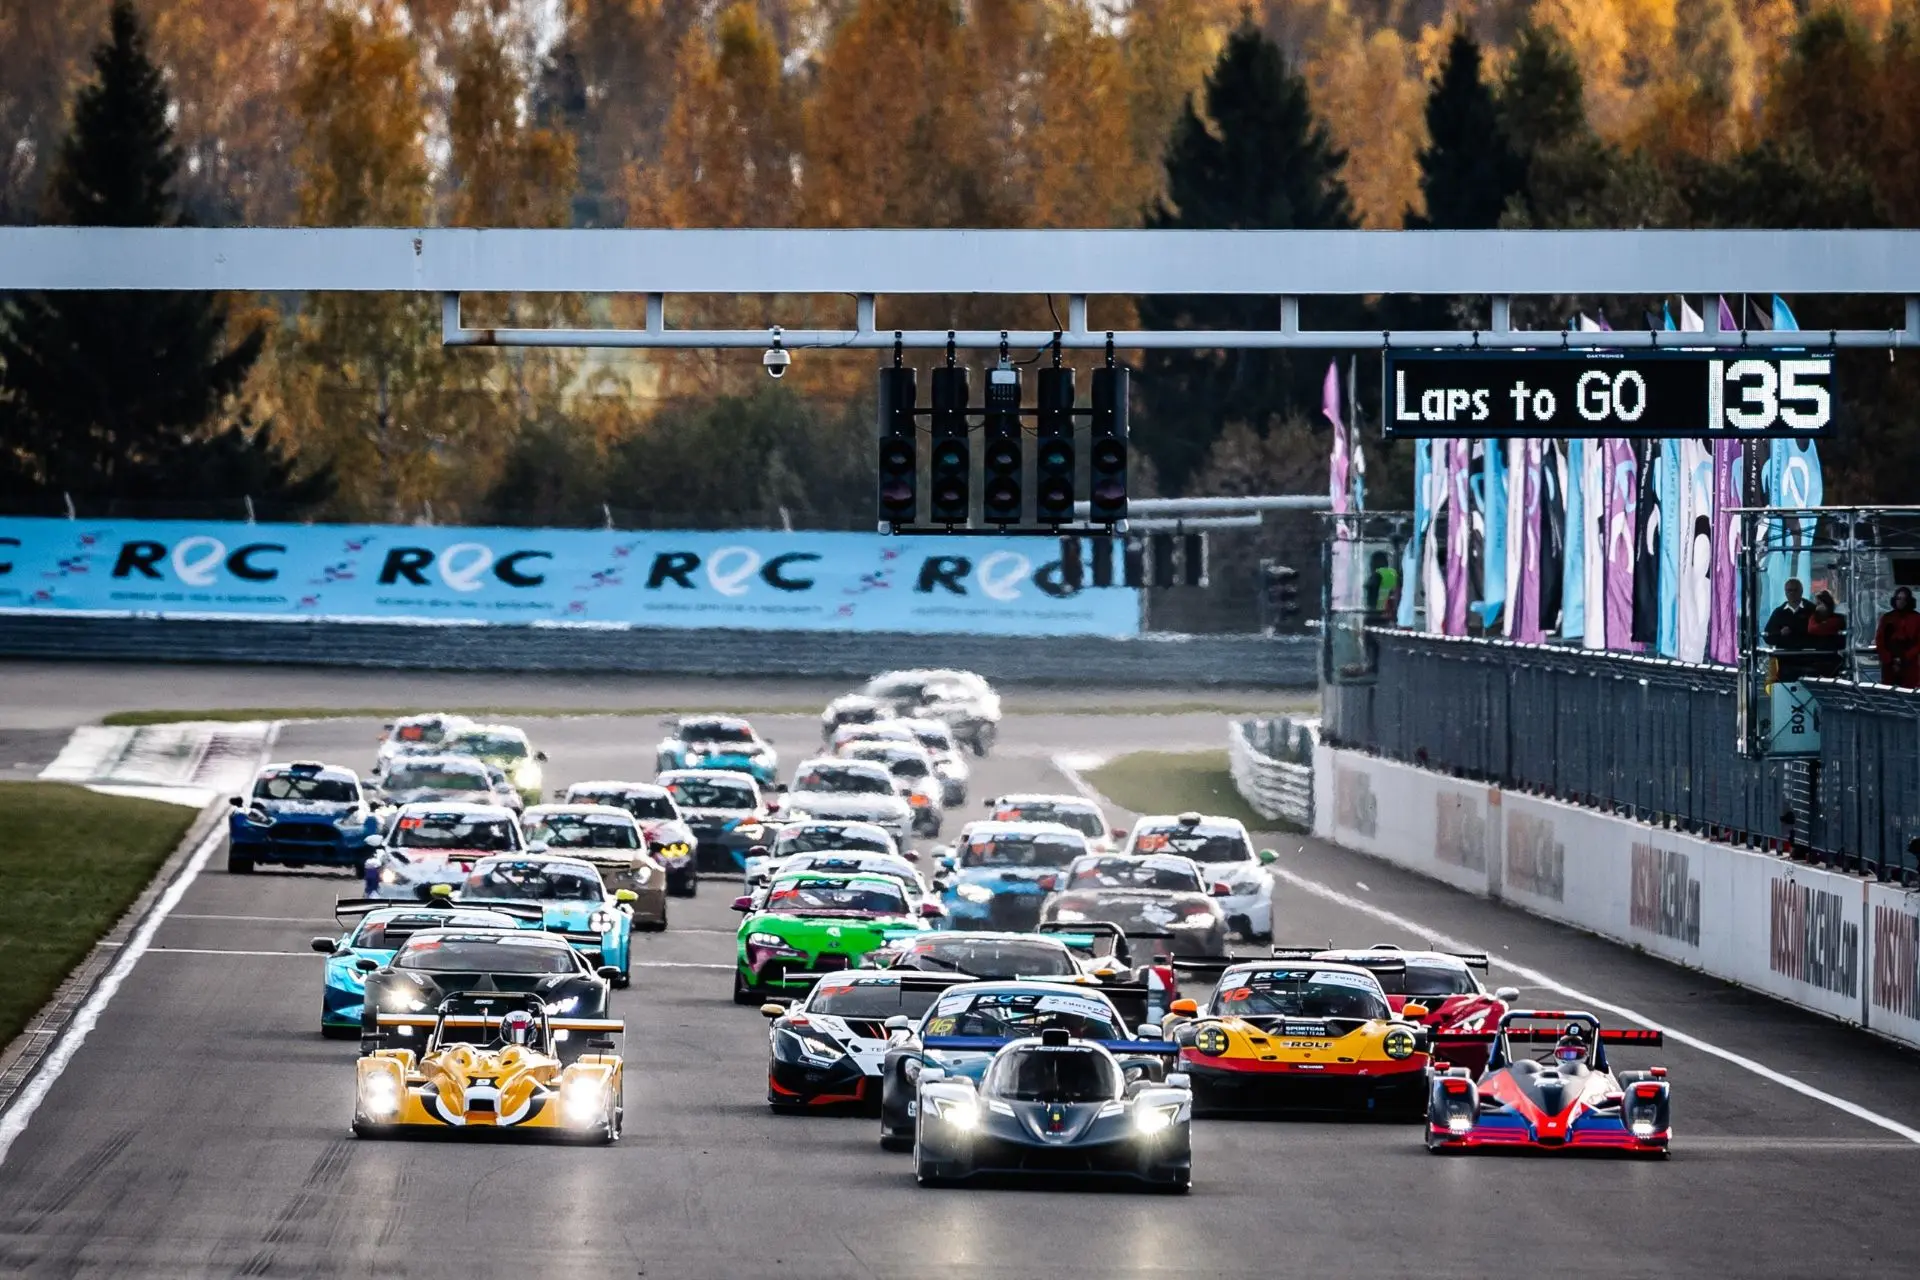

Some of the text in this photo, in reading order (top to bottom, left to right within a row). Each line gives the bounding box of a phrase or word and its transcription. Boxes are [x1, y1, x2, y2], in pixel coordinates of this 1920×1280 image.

[1396, 360, 1831, 429] Laps to GO 135
[1791, 704, 1805, 734] BOX
